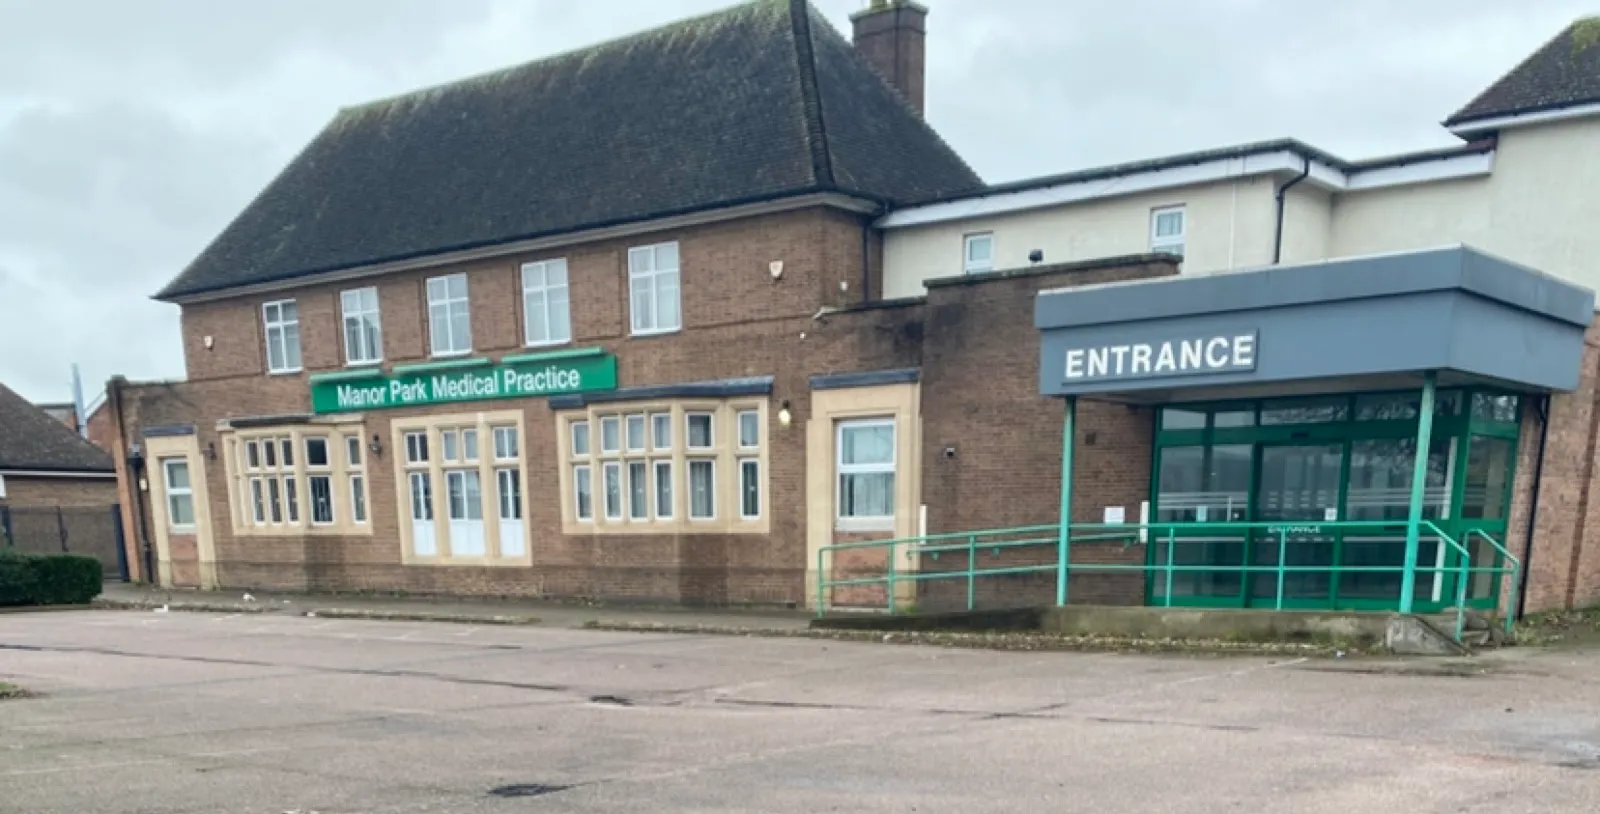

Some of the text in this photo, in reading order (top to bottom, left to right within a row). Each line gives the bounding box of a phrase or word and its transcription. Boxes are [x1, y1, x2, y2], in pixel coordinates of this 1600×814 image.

[1065, 334, 1254, 378] ENTRANCE
[337, 366, 581, 407] Manor Park Medical Practice
